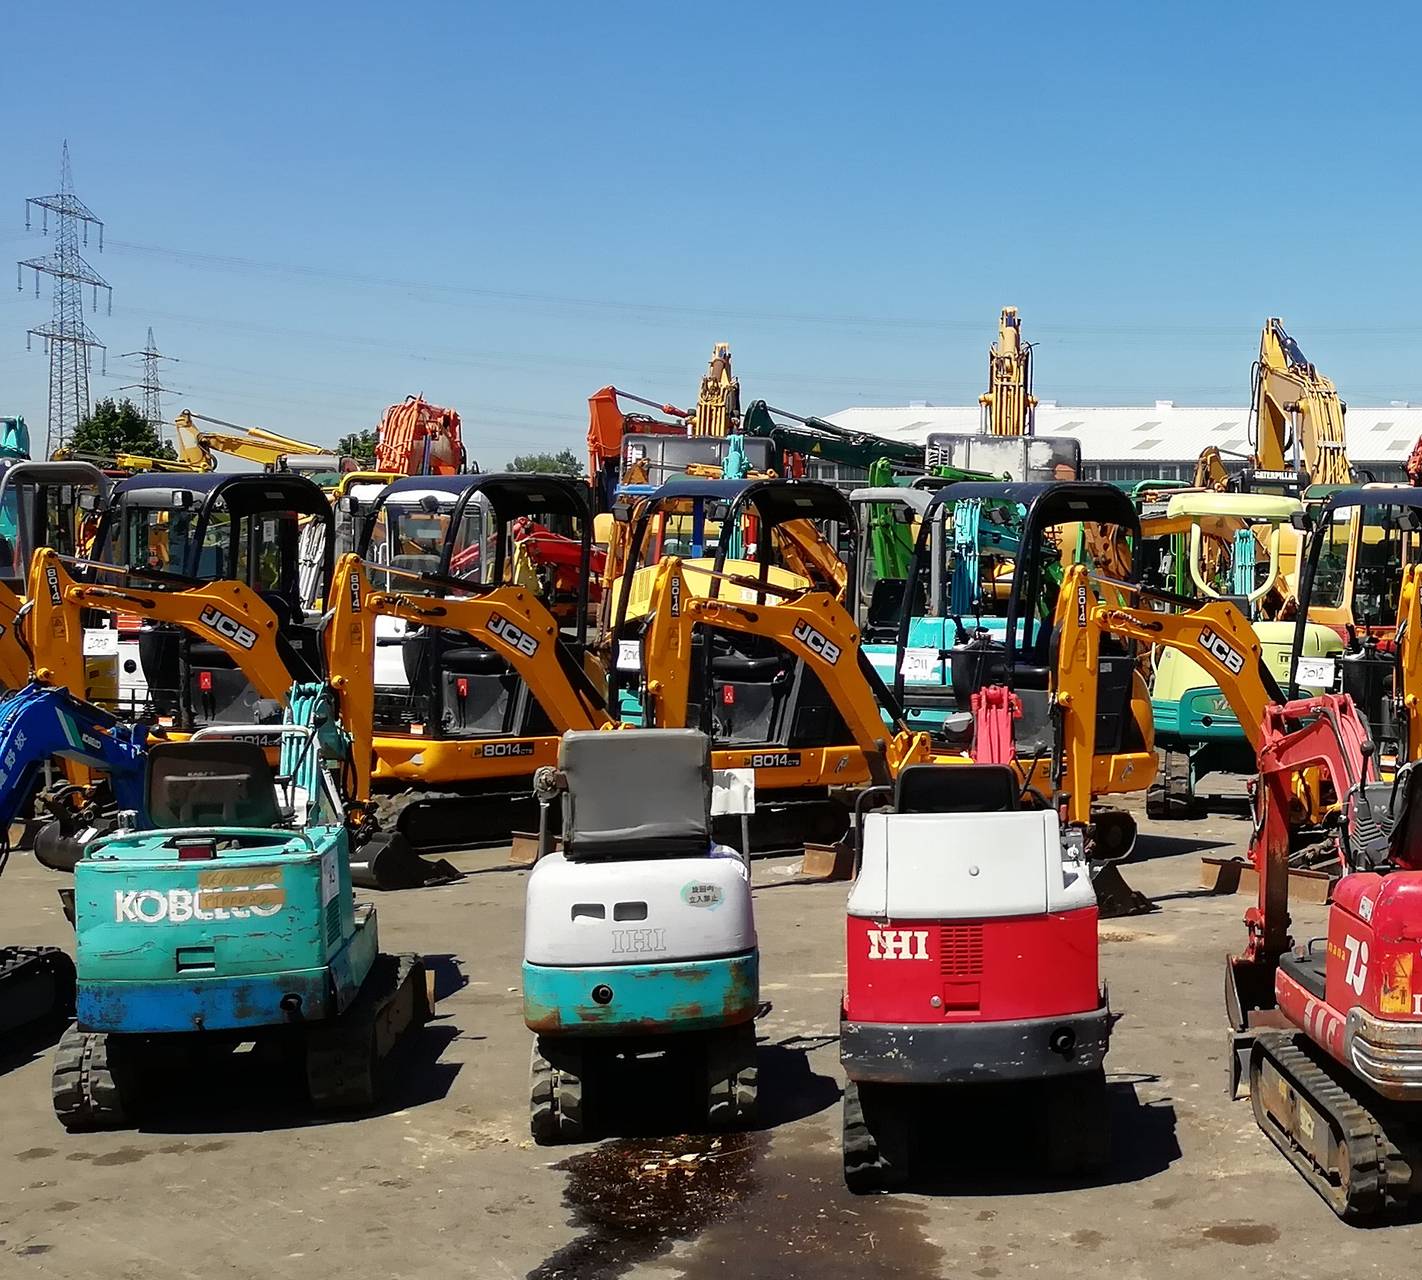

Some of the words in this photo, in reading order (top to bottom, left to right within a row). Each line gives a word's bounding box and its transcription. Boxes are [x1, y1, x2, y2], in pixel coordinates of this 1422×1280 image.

[1254, 471, 1298, 480] CATERPILLAR
[47, 568, 60, 601] 8014
[350, 574, 360, 608] 8014
[671, 578, 680, 612] 8014
[1078, 587, 1087, 622] 8014
[201, 611, 257, 648] JCB
[489, 617, 537, 656] JCB
[794, 625, 840, 664] JCB
[1200, 633, 1243, 673] JCB
[1303, 667, 1324, 680] 2012
[484, 743, 520, 757] 8014
[753, 754, 788, 767] 8014
[612, 929, 666, 953] IHI
[867, 930, 929, 959] IHI
